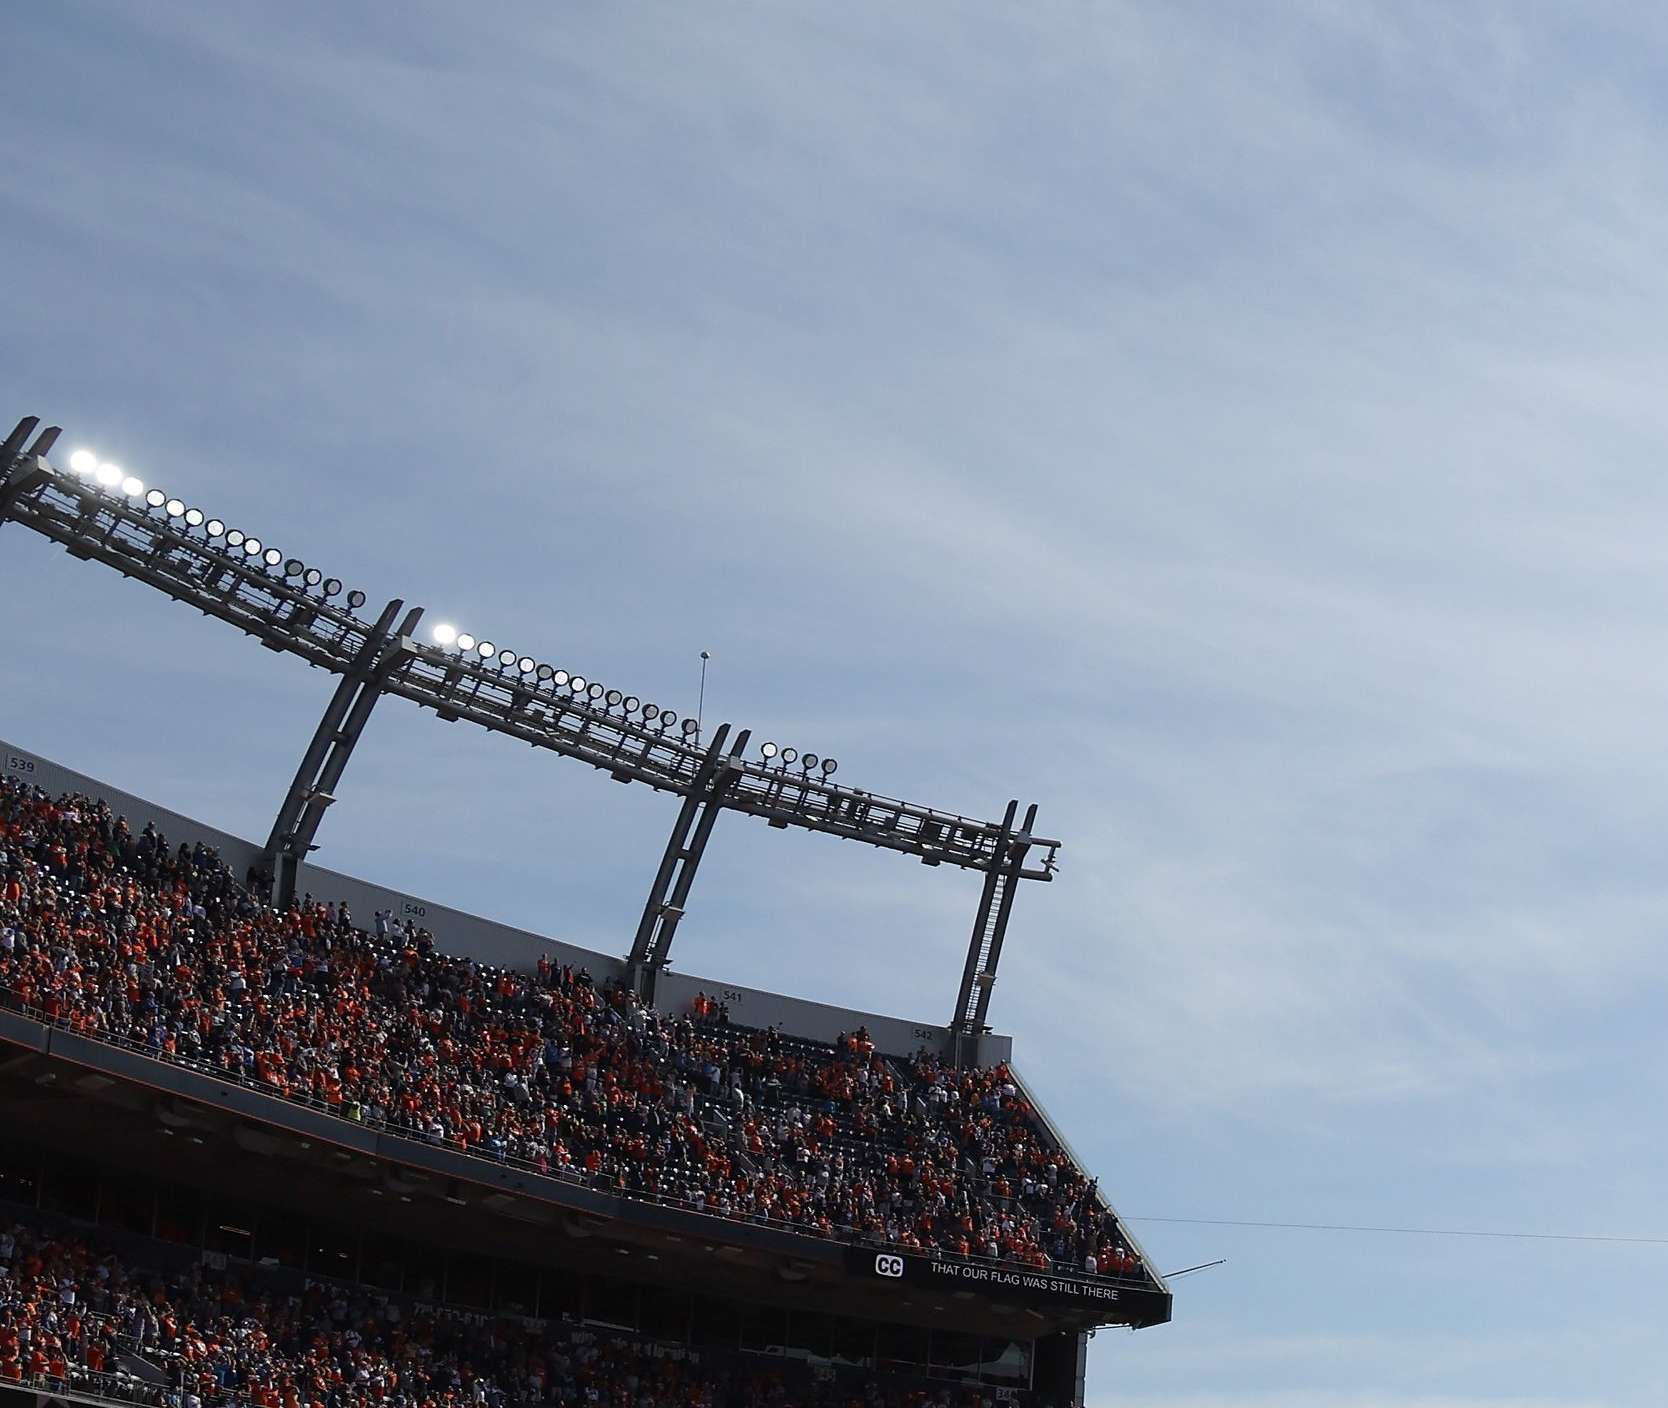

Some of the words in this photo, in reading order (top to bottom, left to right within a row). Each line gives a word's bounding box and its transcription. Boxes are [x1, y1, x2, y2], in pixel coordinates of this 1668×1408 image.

[10, 757, 35, 773] 539
[404, 904, 426, 917] 540
[723, 990, 742, 1001] 541
[913, 1029, 934, 1041] 542
[877, 1256, 902, 1276] CC
[931, 1261, 961, 1276] THAT
[962, 1265, 988, 1281] OUR
[990, 1270, 1020, 1286] FLAG
[1023, 1275, 1048, 1290] WAS
[1050, 1280, 1080, 1296] STILL
[1082, 1284, 1119, 1302] THERE
